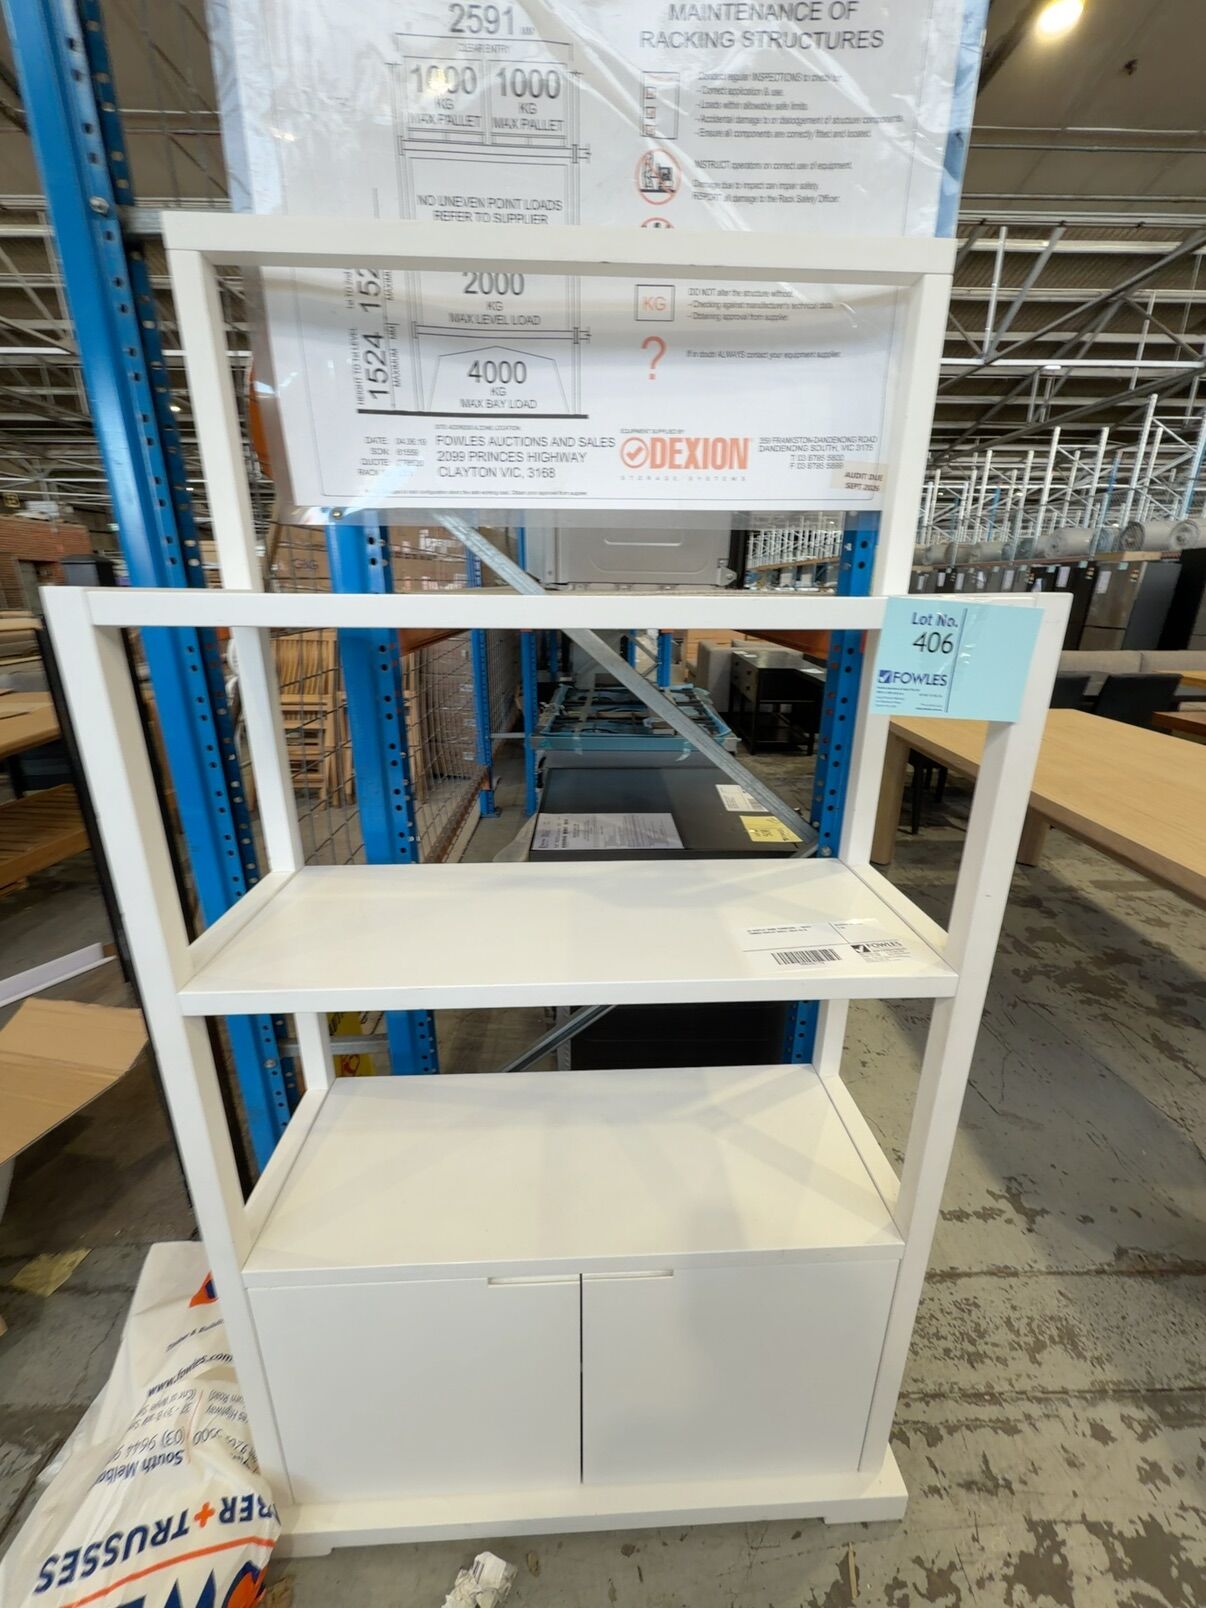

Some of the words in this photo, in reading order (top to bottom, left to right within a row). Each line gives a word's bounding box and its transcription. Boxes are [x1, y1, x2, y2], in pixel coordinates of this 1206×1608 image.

[668, 1, 822, 22] MAINTENANCE
[829, 0, 859, 20] OF
[450, 4, 515, 35] 2591
[640, 31, 735, 48] RACKING
[742, 30, 884, 49] STRUCTURES
[496, 67, 561, 99] 1000
[752, 72, 802, 81] INSPECTIONS
[435, 97, 454, 109] KG
[519, 103, 537, 114] KG
[408, 113, 438, 125] MAX
[440, 114, 482, 127] PALLET
[492, 117, 519, 130] MAX
[522, 119, 564, 131] PALLET
[417, 195, 434, 206] NO
[439, 196, 486, 208] UNEVEN
[488, 197, 522, 209] POINT
[525, 199, 563, 211] LOADS
[434, 210, 472, 222] REFER
[474, 212, 491, 223] TO
[494, 213, 549, 225] SUPPLIER
[357, 268, 382, 312] 152
[463, 272, 525, 296] 2000
[487, 302, 503, 311] KG
[644, 297, 667, 311] KG
[449, 312, 473, 323] MAX
[476, 313, 508, 325] LEVEL
[511, 315, 541, 326] LOAD
[363, 331, 390, 400] 1524
[390, 348, 401, 388] MAXIMUM
[467, 360, 527, 384] 4000
[490, 387, 507, 396] KG
[461, 399, 484, 409] MAX
[486, 399, 507, 409] BAY
[510, 400, 537, 409] LOAD
[436, 435, 486, 447] FOWLES
[488, 436, 548, 448] AUCTIONS
[551, 437, 576, 448] AND
[579, 437, 616, 449] SALES
[437, 450, 465, 462] 2099
[468, 450, 524, 463] PRINCES
[527, 451, 588, 464] HIGHWAY
[650, 437, 750, 470] DEXION
[438, 466, 497, 479] CLAYTON
[528, 466, 556, 479] 3168
[911, 612, 933, 626] Lot
[936, 613, 959, 628] No.
[912, 631, 954, 654] 406
[892, 671, 948, 687] FOWLES
[161, 1426, 185, 1448] (03)
[142, 1450, 184, 1474] South
[95, 1460, 140, 1485] Melbo
[34, 1508, 189, 1595] TRUSSES
